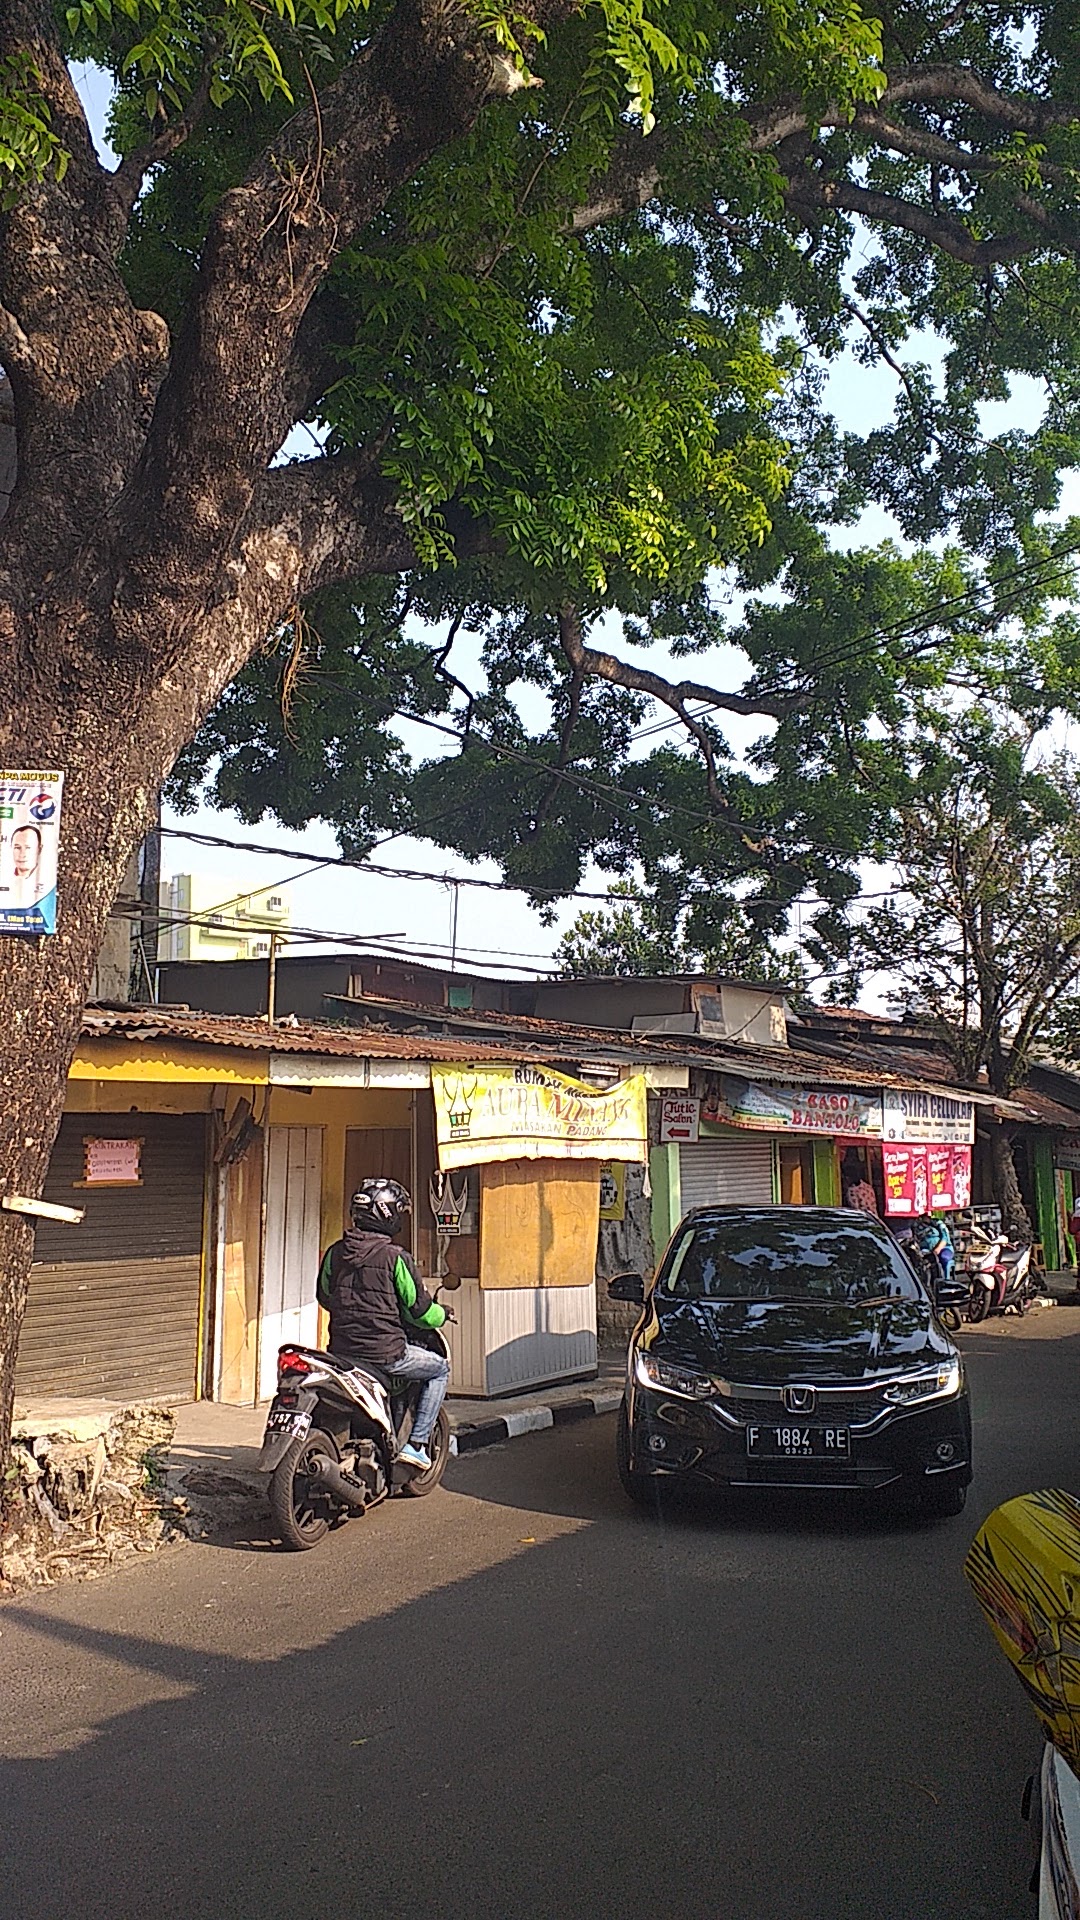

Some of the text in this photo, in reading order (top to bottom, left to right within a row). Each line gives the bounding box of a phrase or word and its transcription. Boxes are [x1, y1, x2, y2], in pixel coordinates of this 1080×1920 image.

[901, 1092, 928, 1118] SYIFA
[931, 1094, 972, 1120] CELLULAR
[791, 1109, 860, 1130] BANTOLO
[750, 1428, 846, 1448] F 1884 RE
